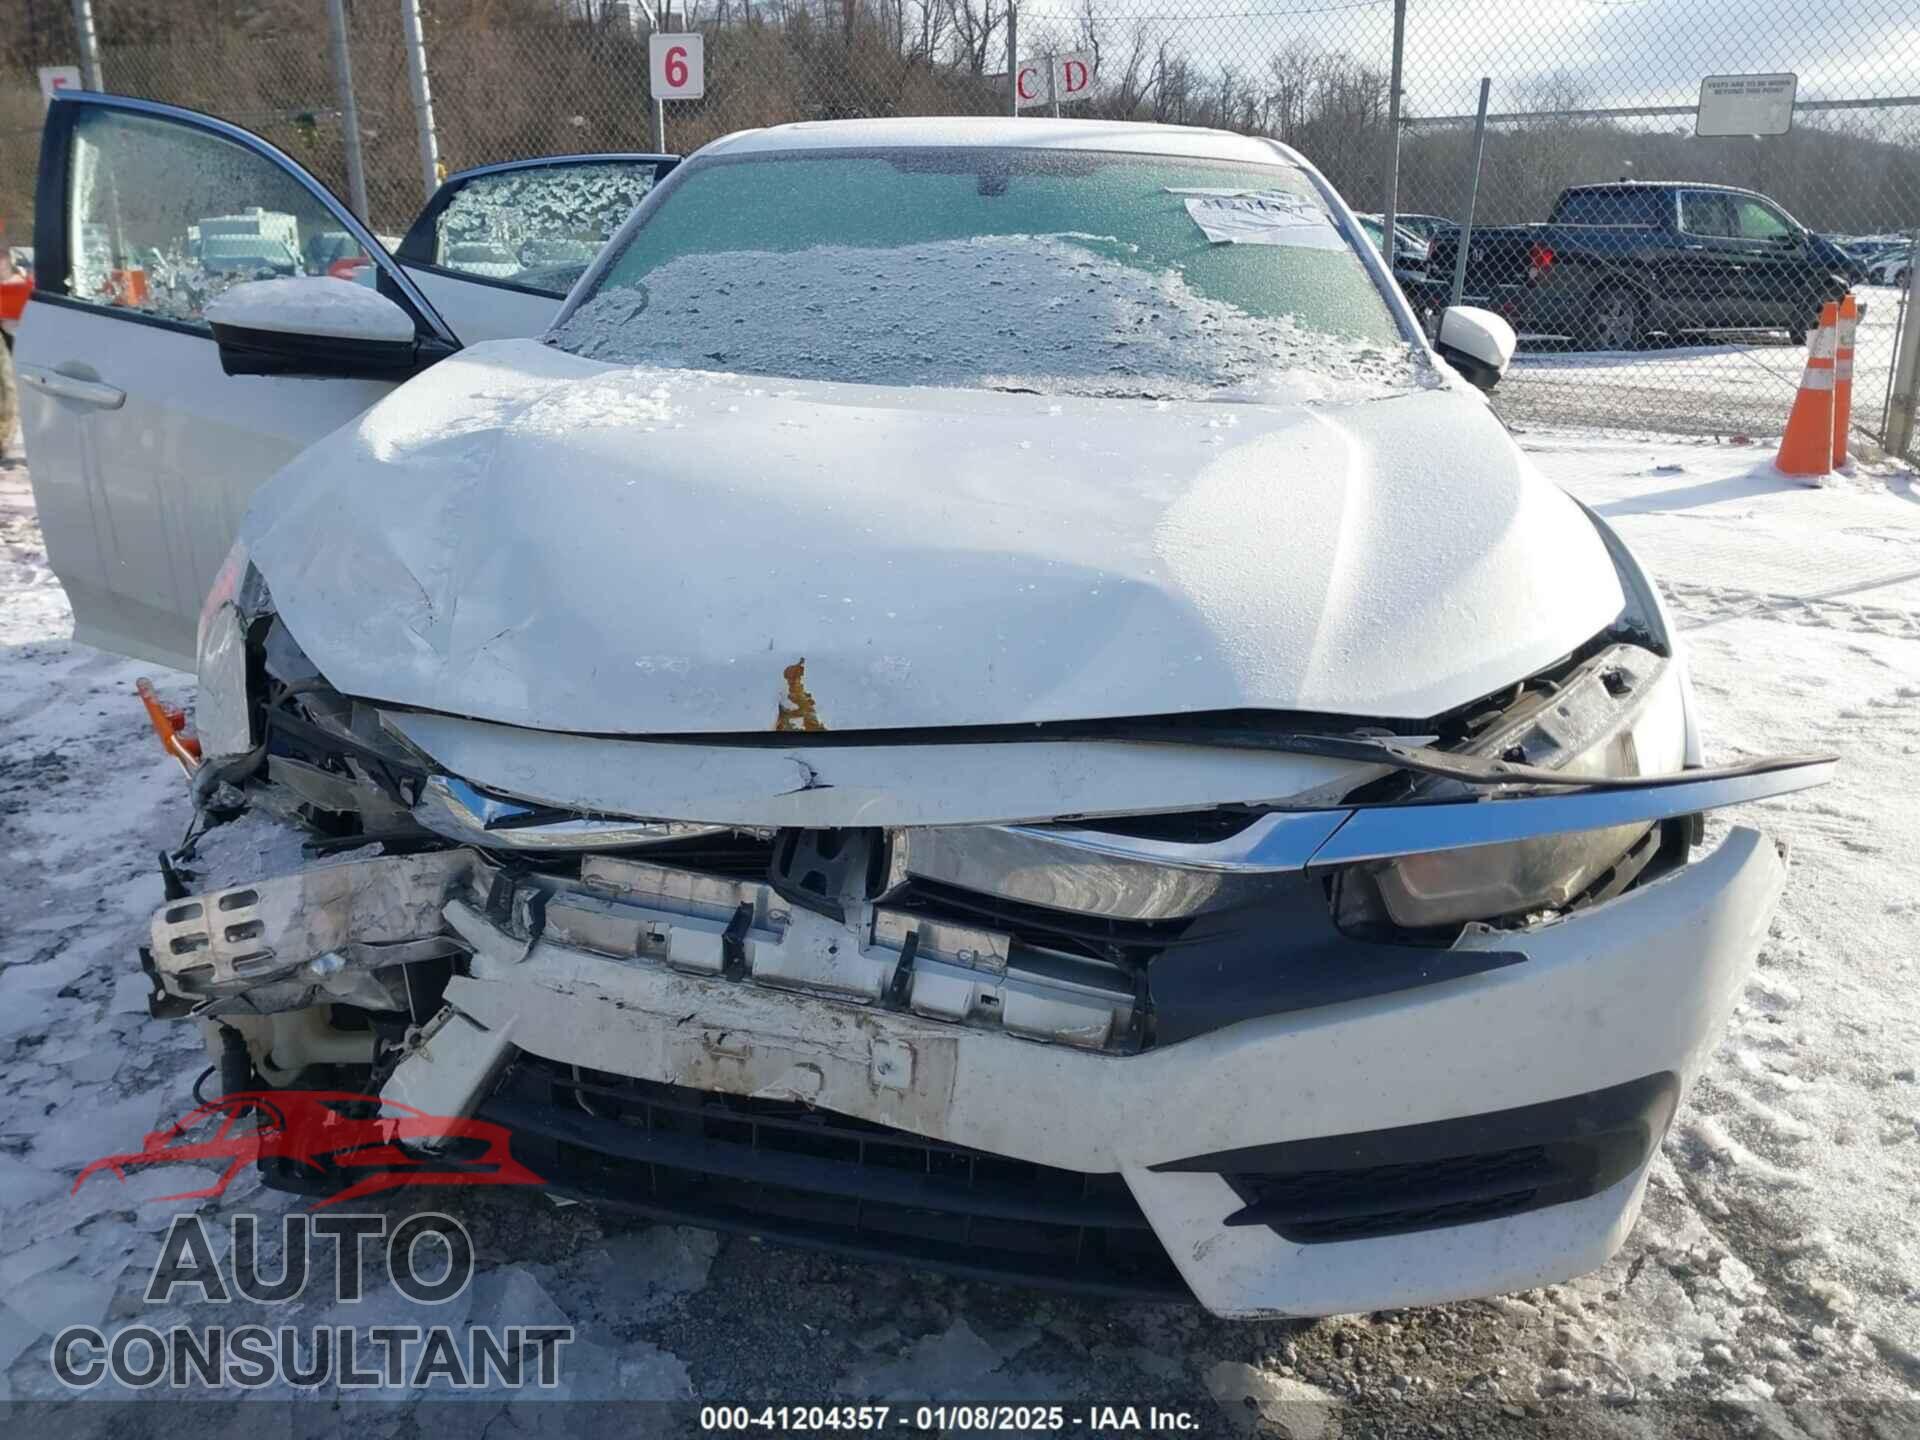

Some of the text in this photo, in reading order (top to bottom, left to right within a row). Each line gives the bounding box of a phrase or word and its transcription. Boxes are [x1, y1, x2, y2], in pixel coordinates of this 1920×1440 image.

[664, 45, 689, 88] 6
[1063, 60, 1088, 92] D
[1017, 67, 1040, 100] C
